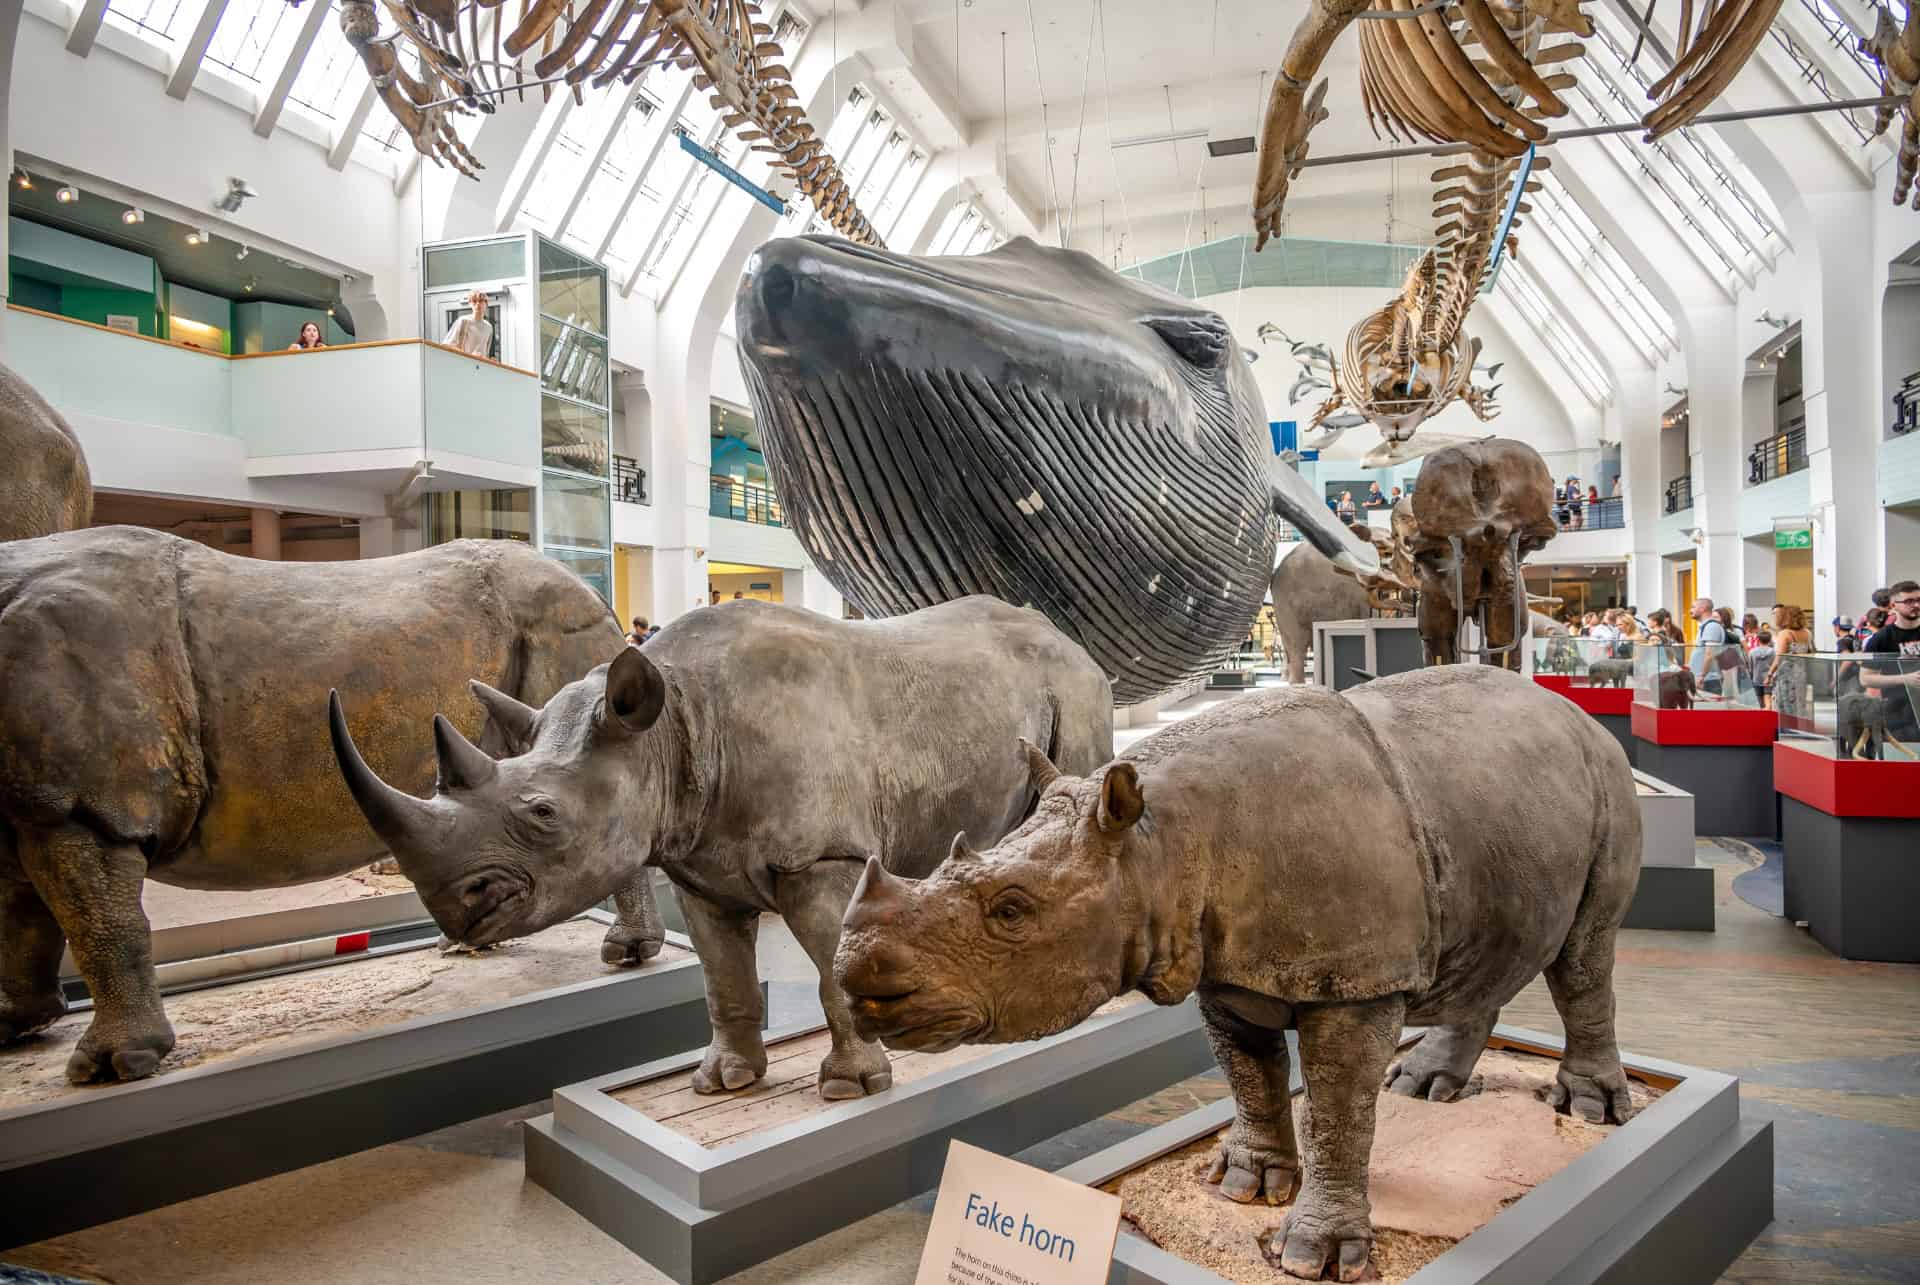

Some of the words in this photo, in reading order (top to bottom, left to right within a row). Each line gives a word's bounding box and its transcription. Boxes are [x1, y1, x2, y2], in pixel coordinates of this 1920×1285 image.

[964, 1193, 1014, 1237] Fake
[1019, 1213, 1075, 1262] horn
[951, 1261, 976, 1278] because
[976, 1272, 984, 1280] of
[955, 1247, 966, 1260] The
[966, 1253, 981, 1265] horn
[982, 1260, 991, 1270] on
[992, 1264, 1004, 1276] this
